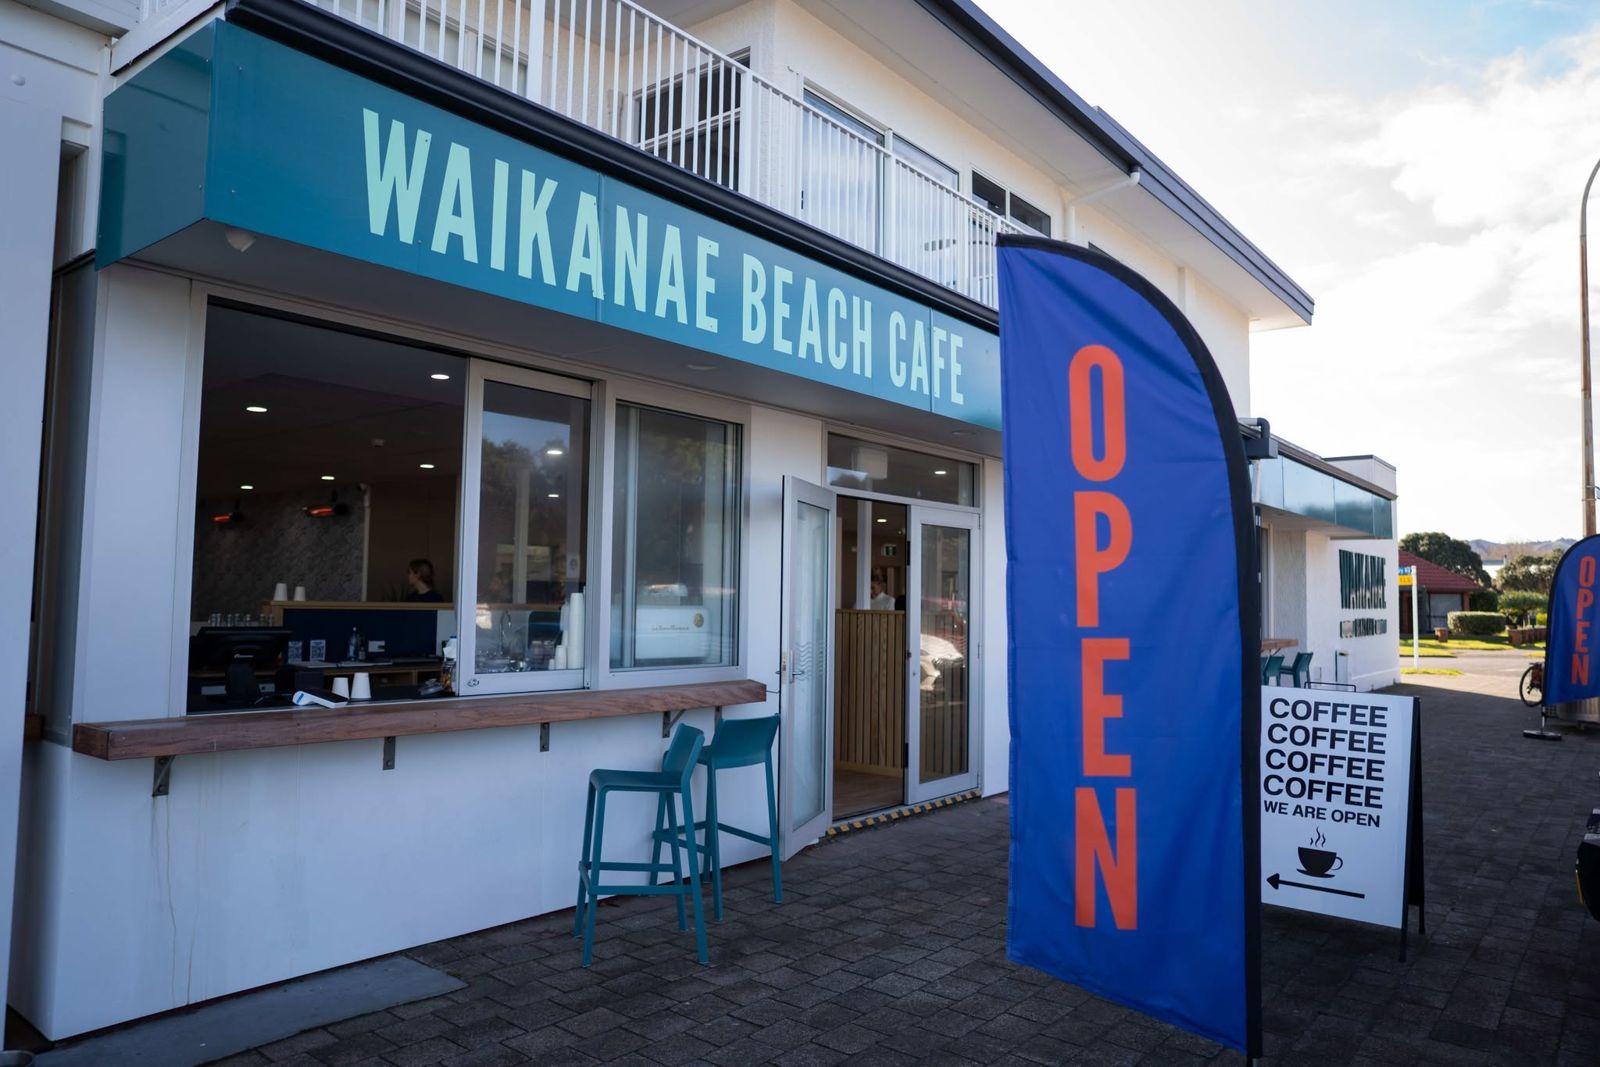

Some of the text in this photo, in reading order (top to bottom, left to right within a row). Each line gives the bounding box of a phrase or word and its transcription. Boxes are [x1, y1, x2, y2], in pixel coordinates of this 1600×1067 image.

[363, 108, 964, 405] WAIKANAE BEACH CAFE
[1570, 555, 1597, 686] OPEN
[1068, 344, 1137, 931] OPEN
[1269, 698, 1388, 728] COFFEE
[1267, 723, 1387, 754] COFFEE
[1265, 749, 1385, 781] COFFEE
[1263, 774, 1383, 809] COFFEE
[1263, 800, 1381, 828] WE ARE OPEN
